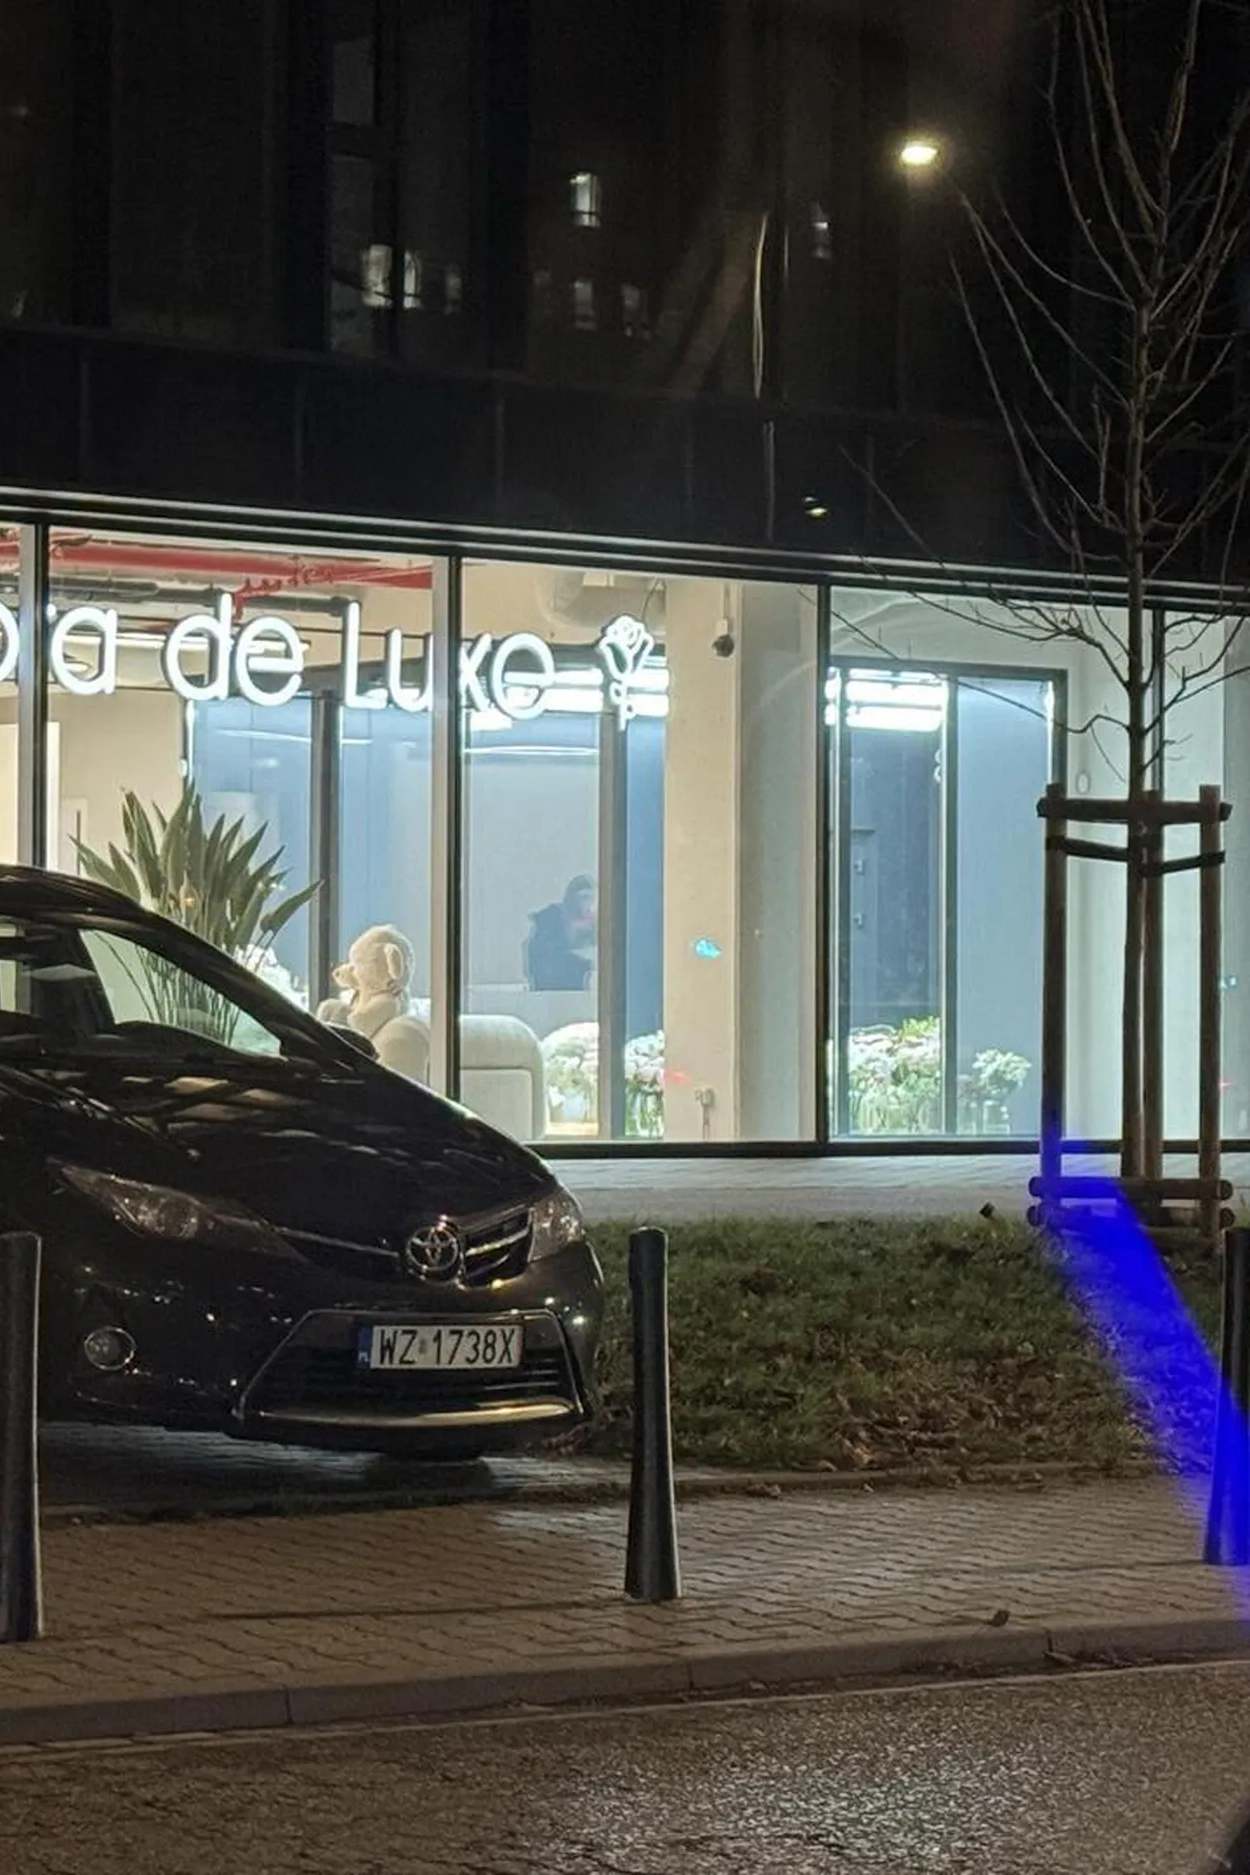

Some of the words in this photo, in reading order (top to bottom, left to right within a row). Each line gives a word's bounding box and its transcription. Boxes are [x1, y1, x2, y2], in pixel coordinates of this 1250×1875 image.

[165, 592, 304, 706] de
[379, 1328, 418, 1365] WZ
[432, 1328, 516, 1365] 1738X
